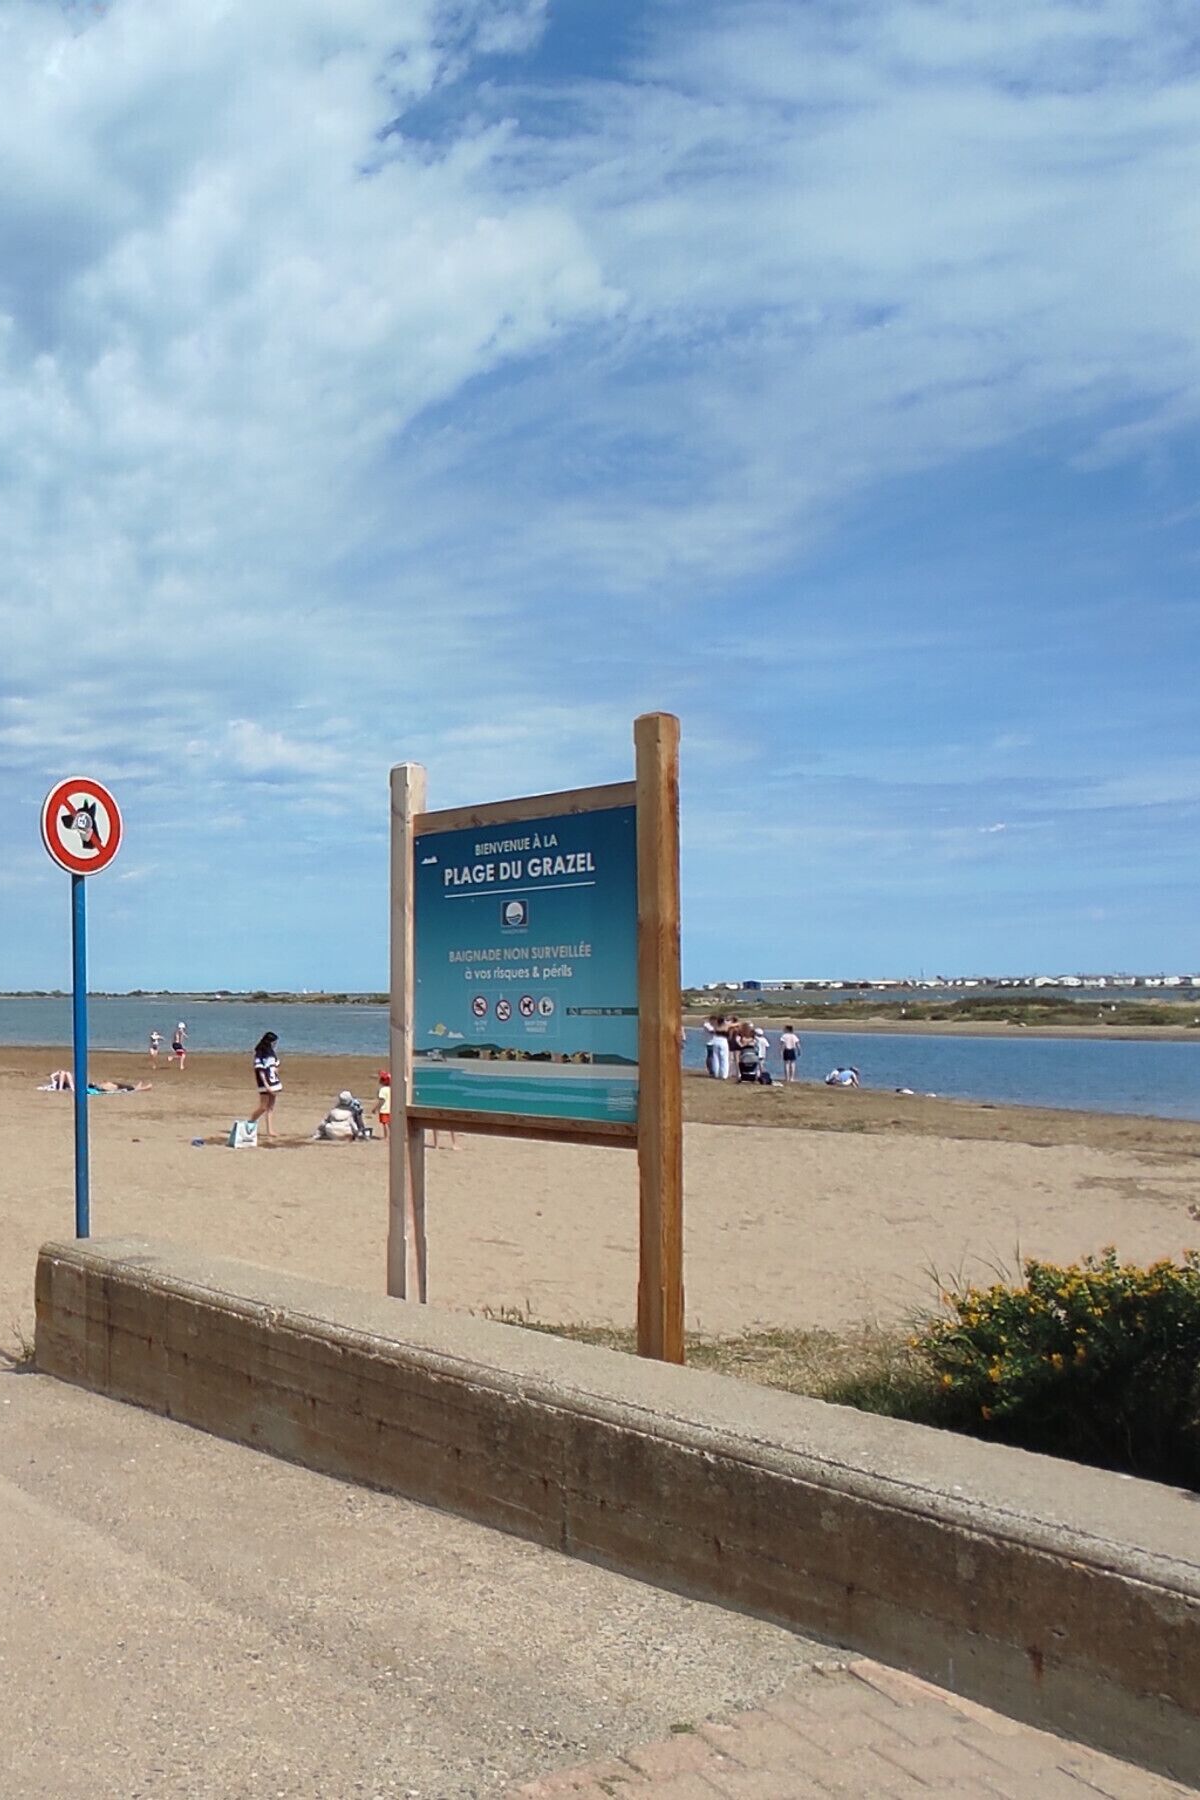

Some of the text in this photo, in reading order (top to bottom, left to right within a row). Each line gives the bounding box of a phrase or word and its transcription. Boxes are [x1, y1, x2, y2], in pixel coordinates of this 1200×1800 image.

[475, 833, 558, 856] BIENVENUE À LA
[444, 852, 595, 886] PLAGE DU GRAZEL
[448, 940, 591, 962] BAIGNADE NON SURVEILLÉE
[465, 963, 572, 980] à vos risques & périls
